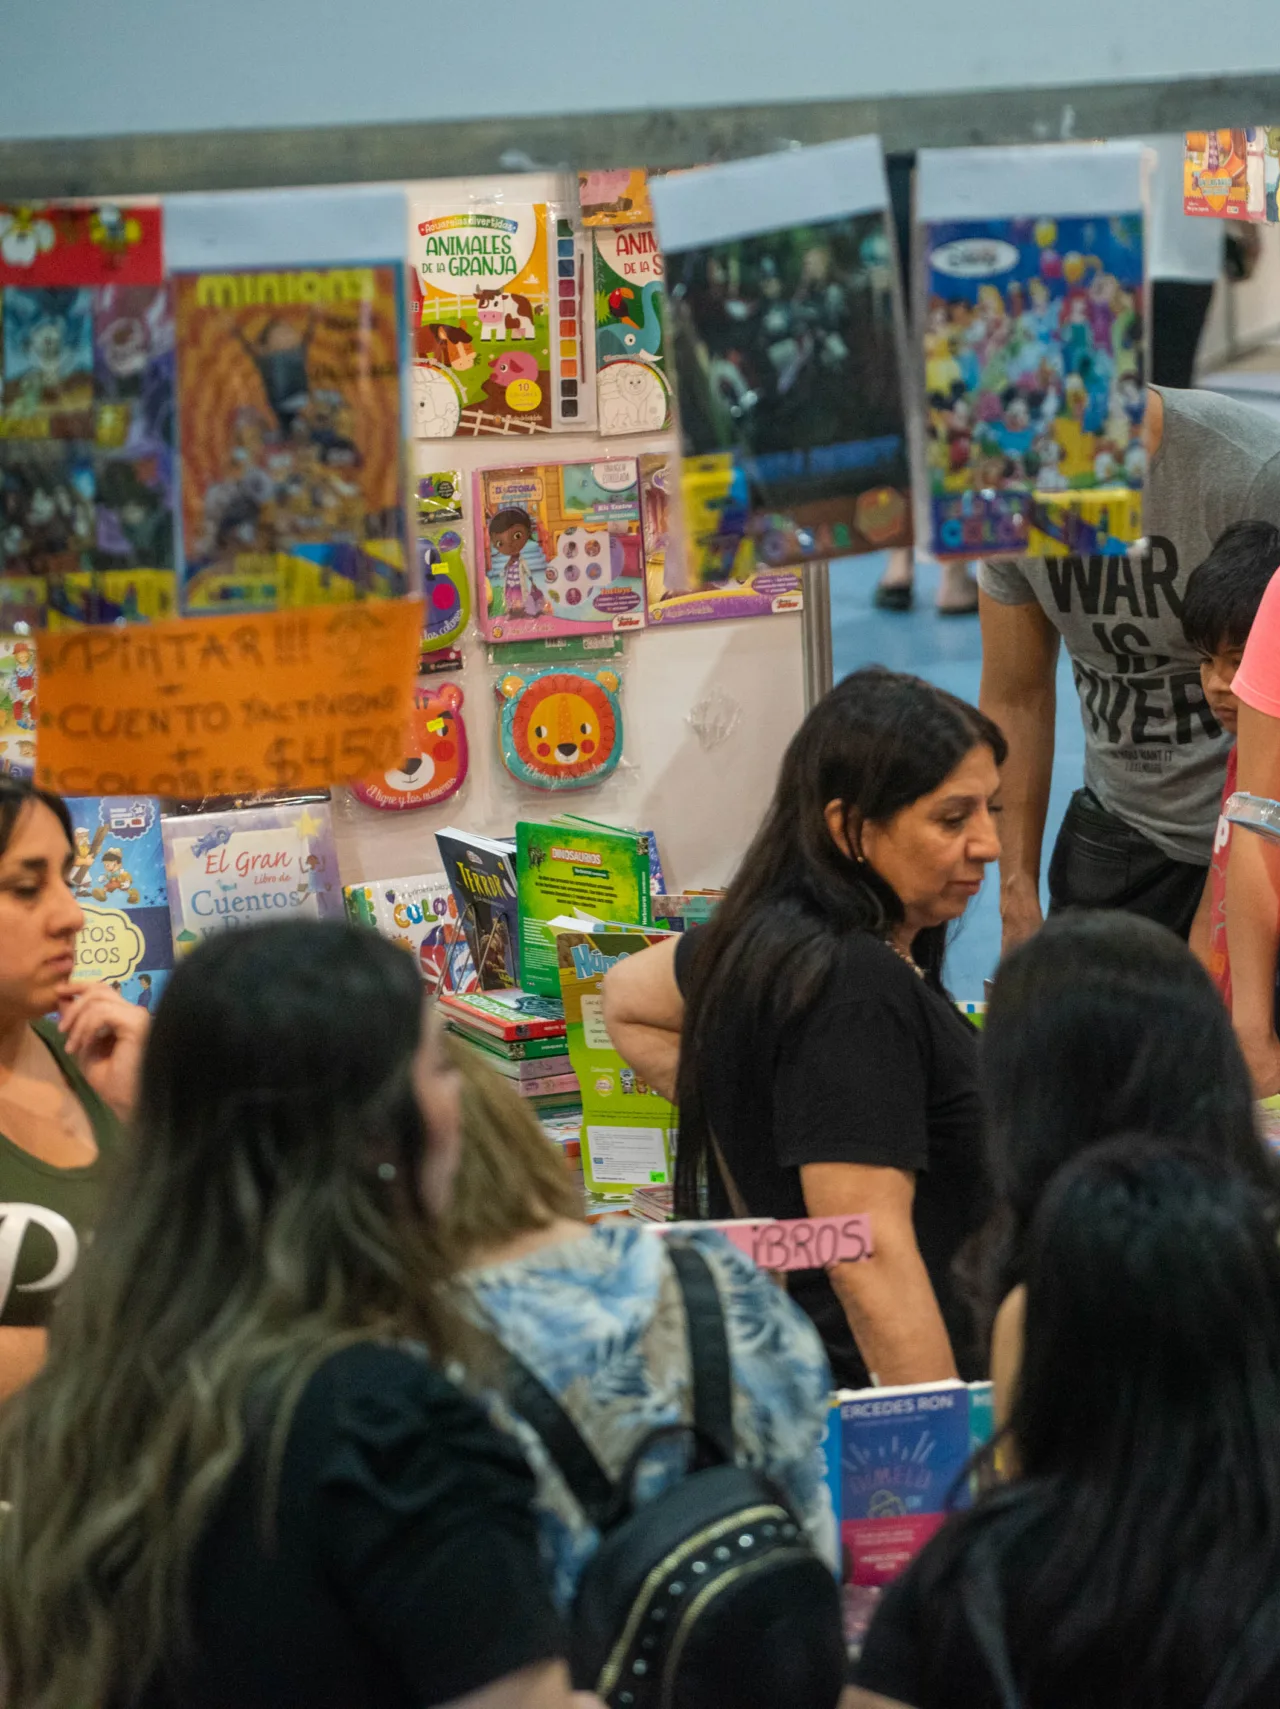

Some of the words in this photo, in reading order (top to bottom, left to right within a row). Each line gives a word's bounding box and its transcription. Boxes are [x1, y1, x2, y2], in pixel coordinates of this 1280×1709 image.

[426, 235, 512, 256] ANIMALES
[422, 263, 433, 274] DE
[437, 262, 446, 273] LA
[448, 255, 517, 276] GRANJA
[624, 262, 637, 275] DE
[640, 261, 650, 273] LA
[518, 382, 530, 392] 10
[1045, 535, 1184, 619] WAR
[424, 629, 439, 641] los
[439, 608, 464, 637] colores
[1092, 622, 1171, 674] IS
[57, 702, 232, 741] CUENTO
[205, 849, 230, 875] El
[235, 850, 292, 877] Gran
[254, 873, 276, 885] Libro
[279, 872, 291, 882] de
[456, 861, 509, 901] TERROR
[191, 890, 300, 917] Cuentos
[917, 1394, 954, 1412] RON
